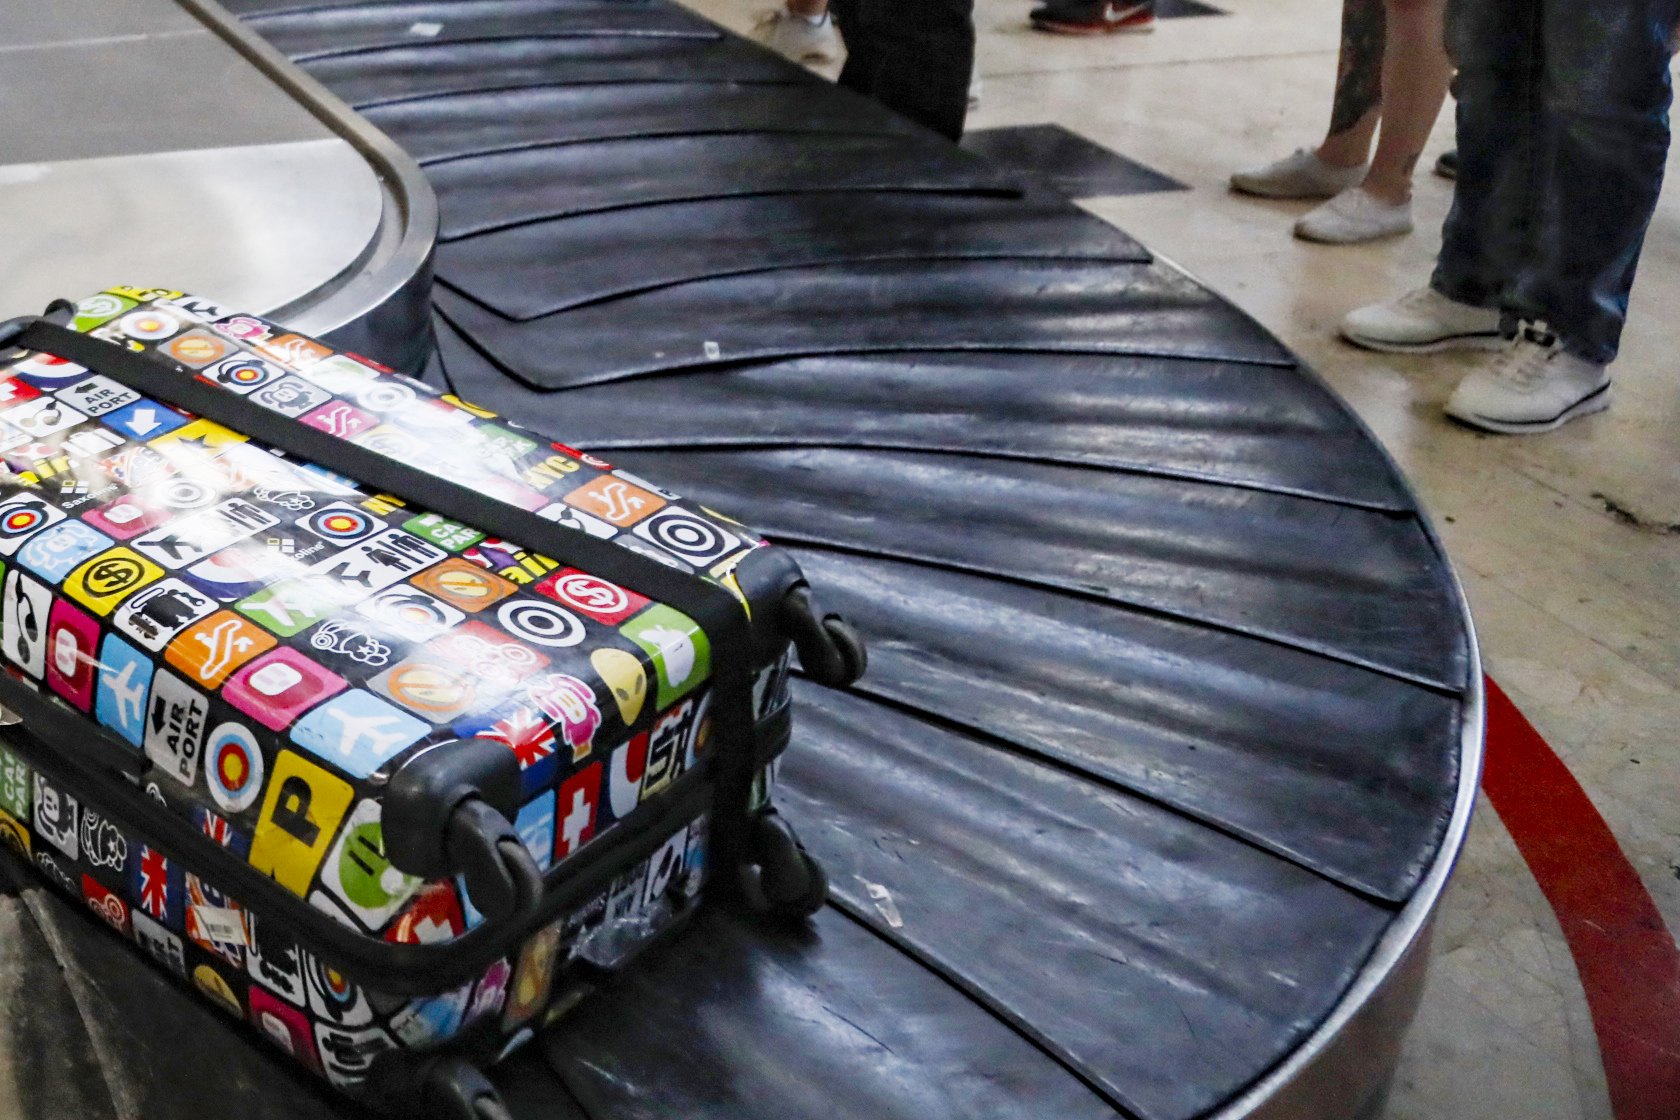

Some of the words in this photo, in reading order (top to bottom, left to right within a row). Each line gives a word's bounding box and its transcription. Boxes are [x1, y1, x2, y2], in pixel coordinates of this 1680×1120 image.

[84, 388, 116, 405] AIR
[87, 391, 132, 414] PORT
[431, 523, 462, 539] CA
[439, 528, 481, 550] PAR
[166, 702, 185, 756] AIR
[179, 698, 203, 779] PORT
